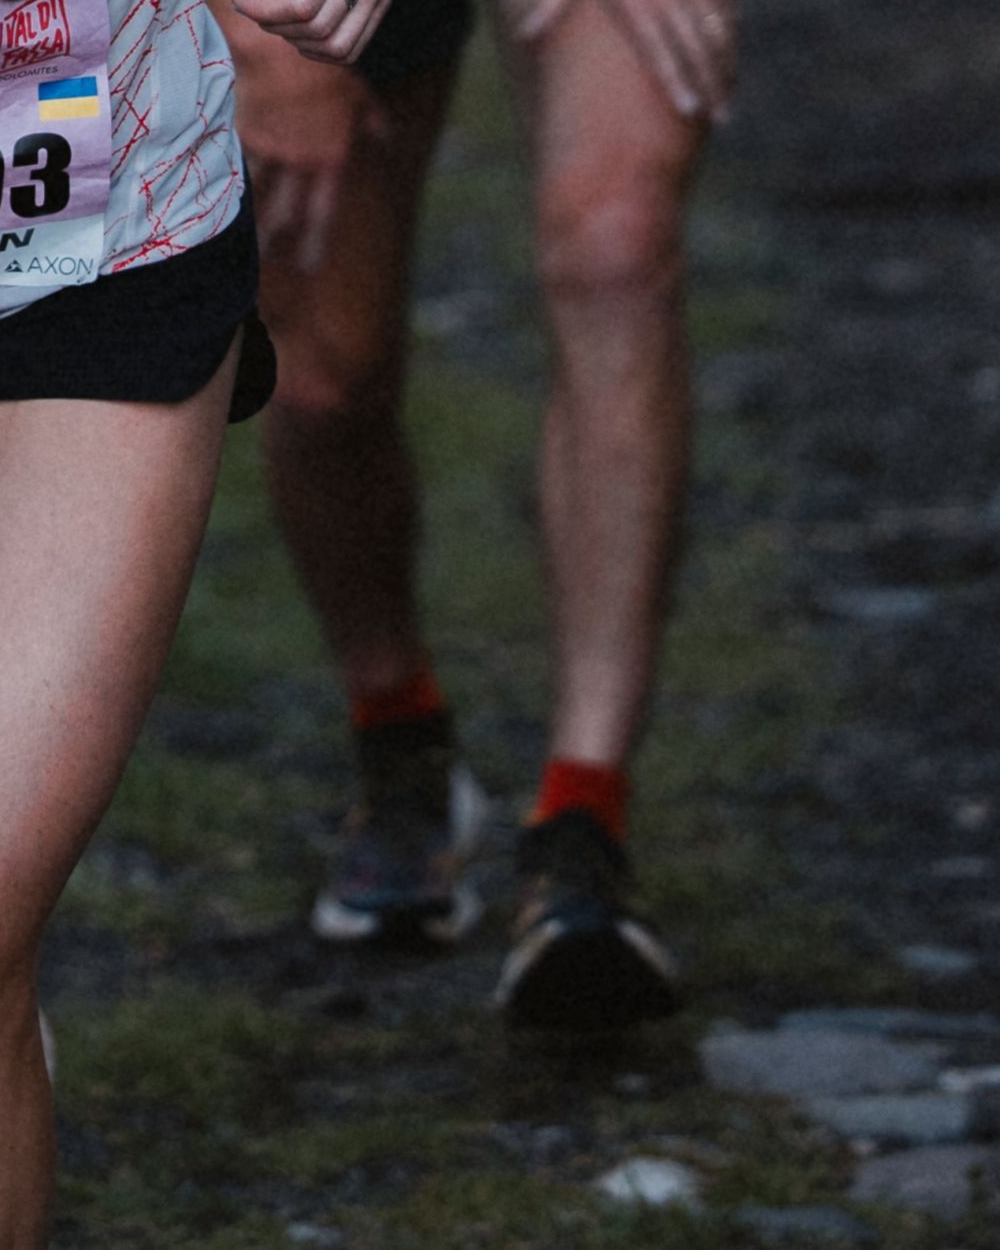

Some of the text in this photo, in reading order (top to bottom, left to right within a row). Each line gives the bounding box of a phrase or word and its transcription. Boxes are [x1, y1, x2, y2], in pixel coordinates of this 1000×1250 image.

[6, 11, 37, 48] VAL
[1, 28, 64, 69] FASSA
[27, 257, 94, 277] AXON
